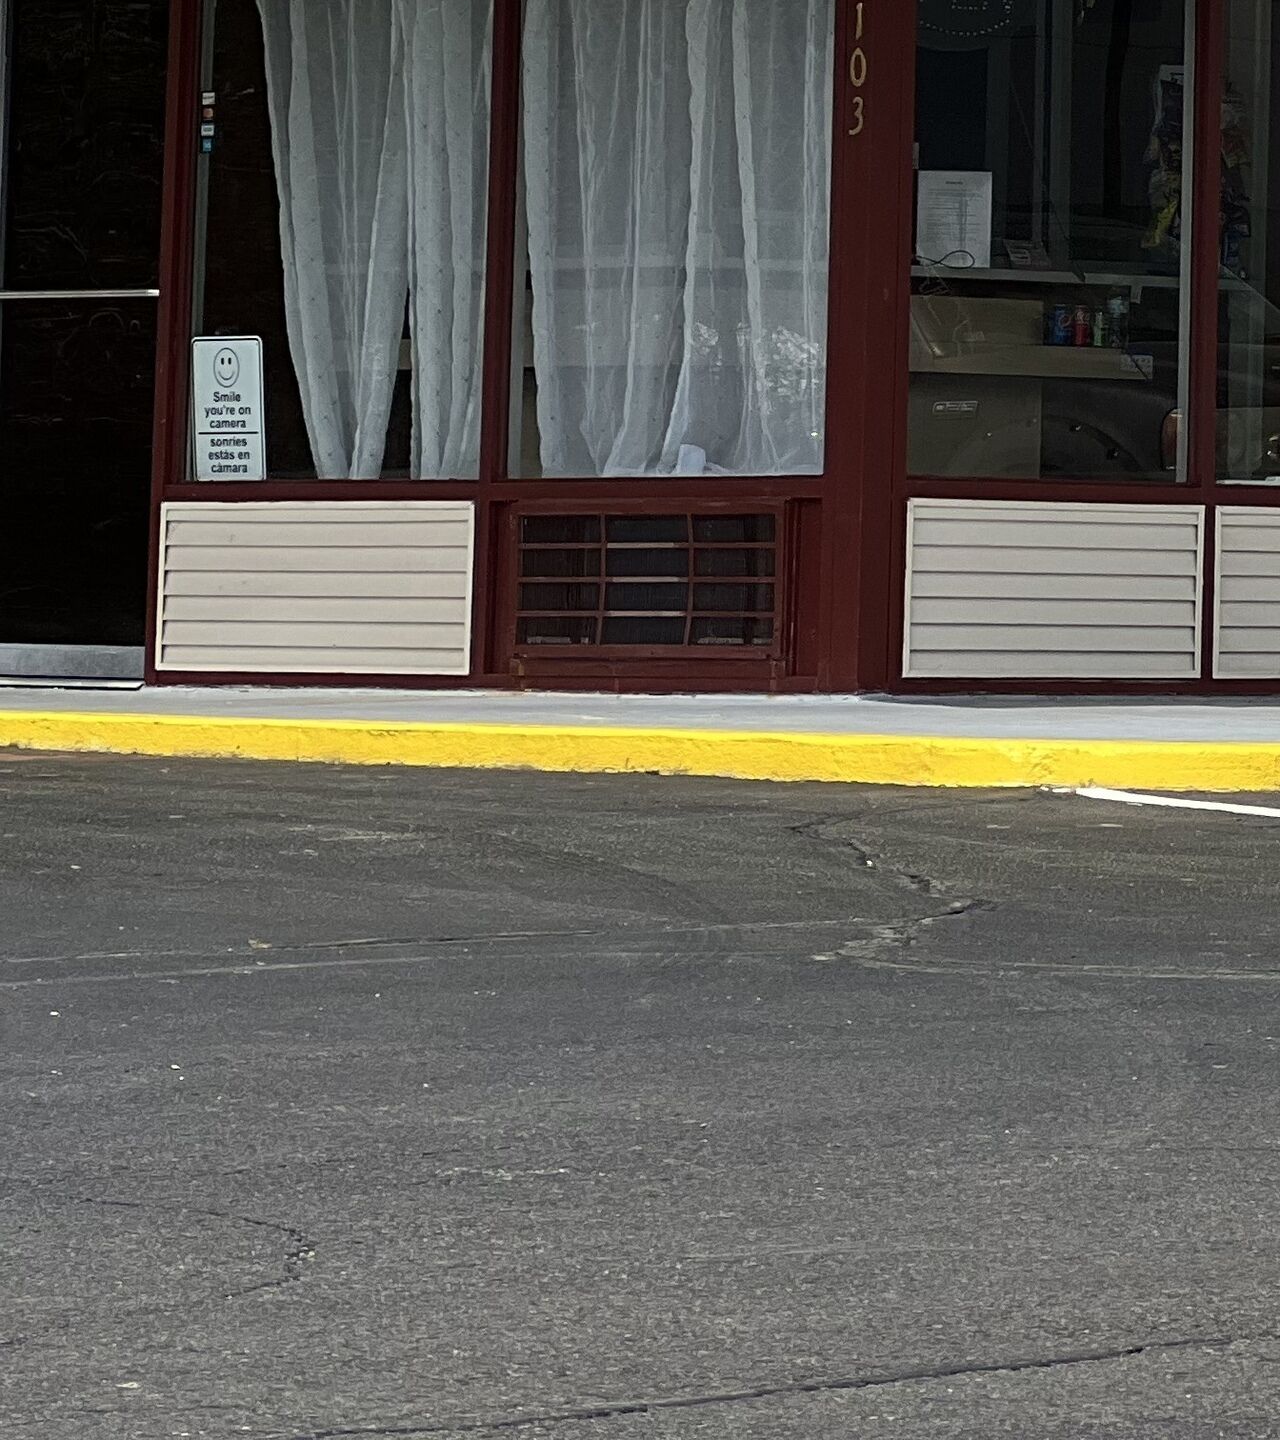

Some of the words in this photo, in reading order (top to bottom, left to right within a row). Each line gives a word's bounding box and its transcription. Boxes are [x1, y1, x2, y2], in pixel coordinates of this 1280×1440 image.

[847, 1, 867, 136] 103
[213, 391, 241, 402] Smile
[204, 404, 236, 419] you're
[238, 406, 252, 416] on
[209, 419, 247, 429] camera
[237, 451, 250, 460] en
